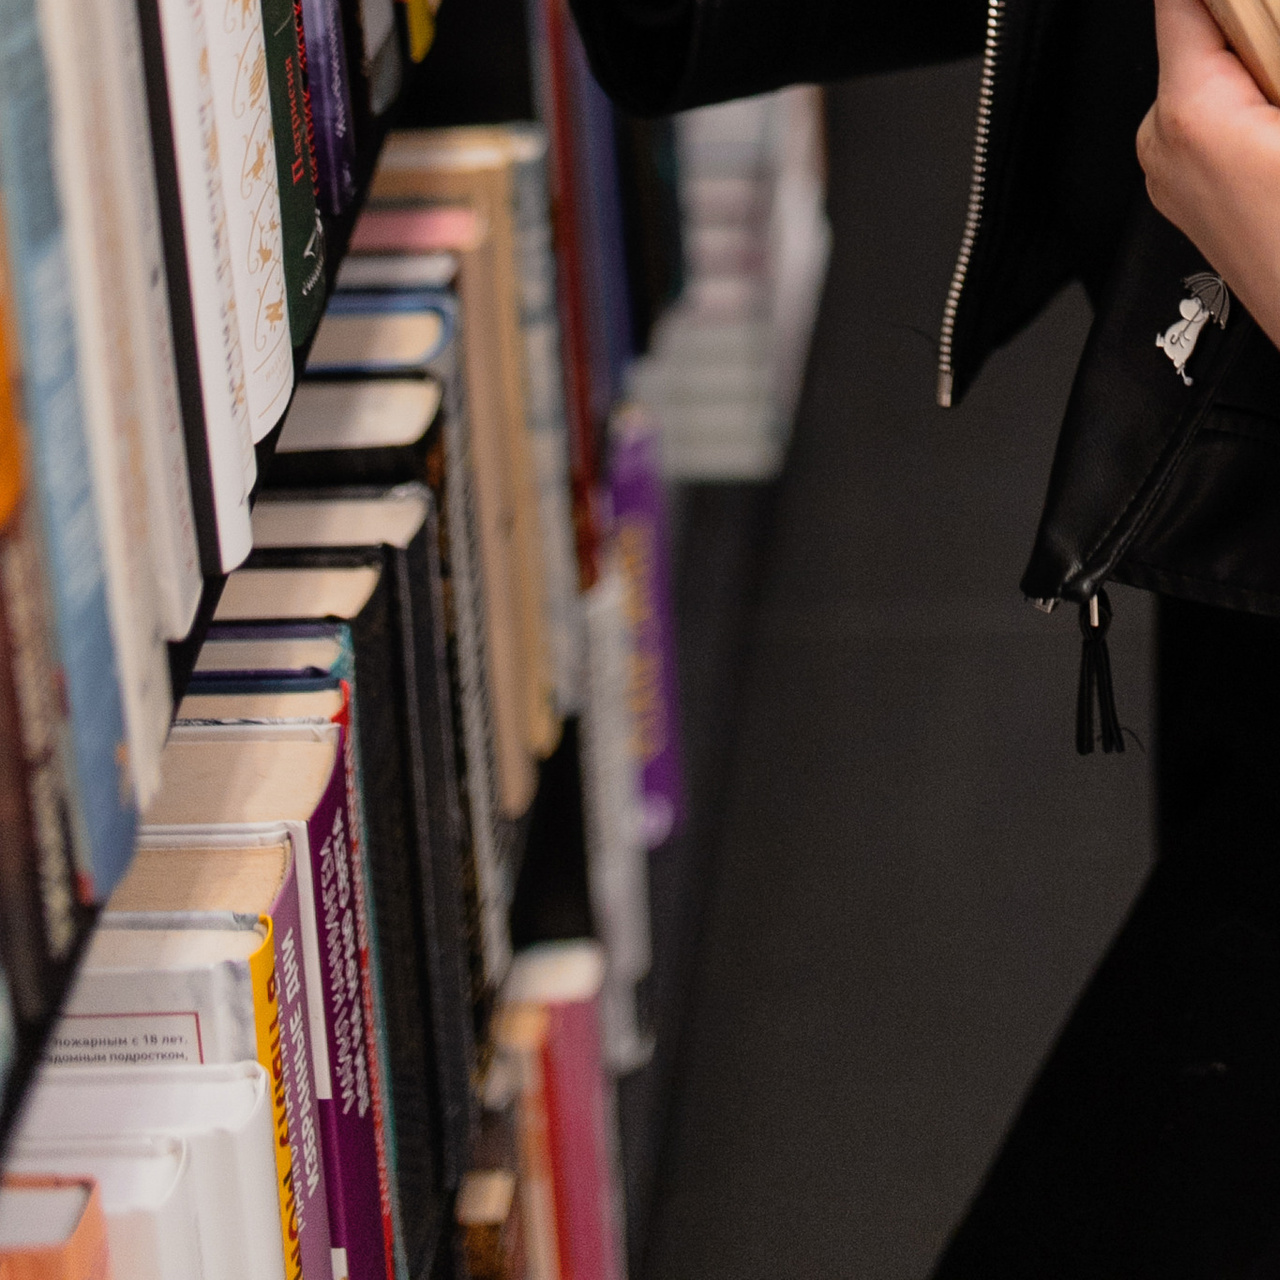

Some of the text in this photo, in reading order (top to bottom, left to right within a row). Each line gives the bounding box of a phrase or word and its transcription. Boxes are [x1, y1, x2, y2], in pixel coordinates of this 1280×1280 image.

[285, 55, 305, 185] Патрисия
[281, 926, 305, 1004] ДНИ
[289, 1000, 320, 1199] ИЗБРАННЫЕ
